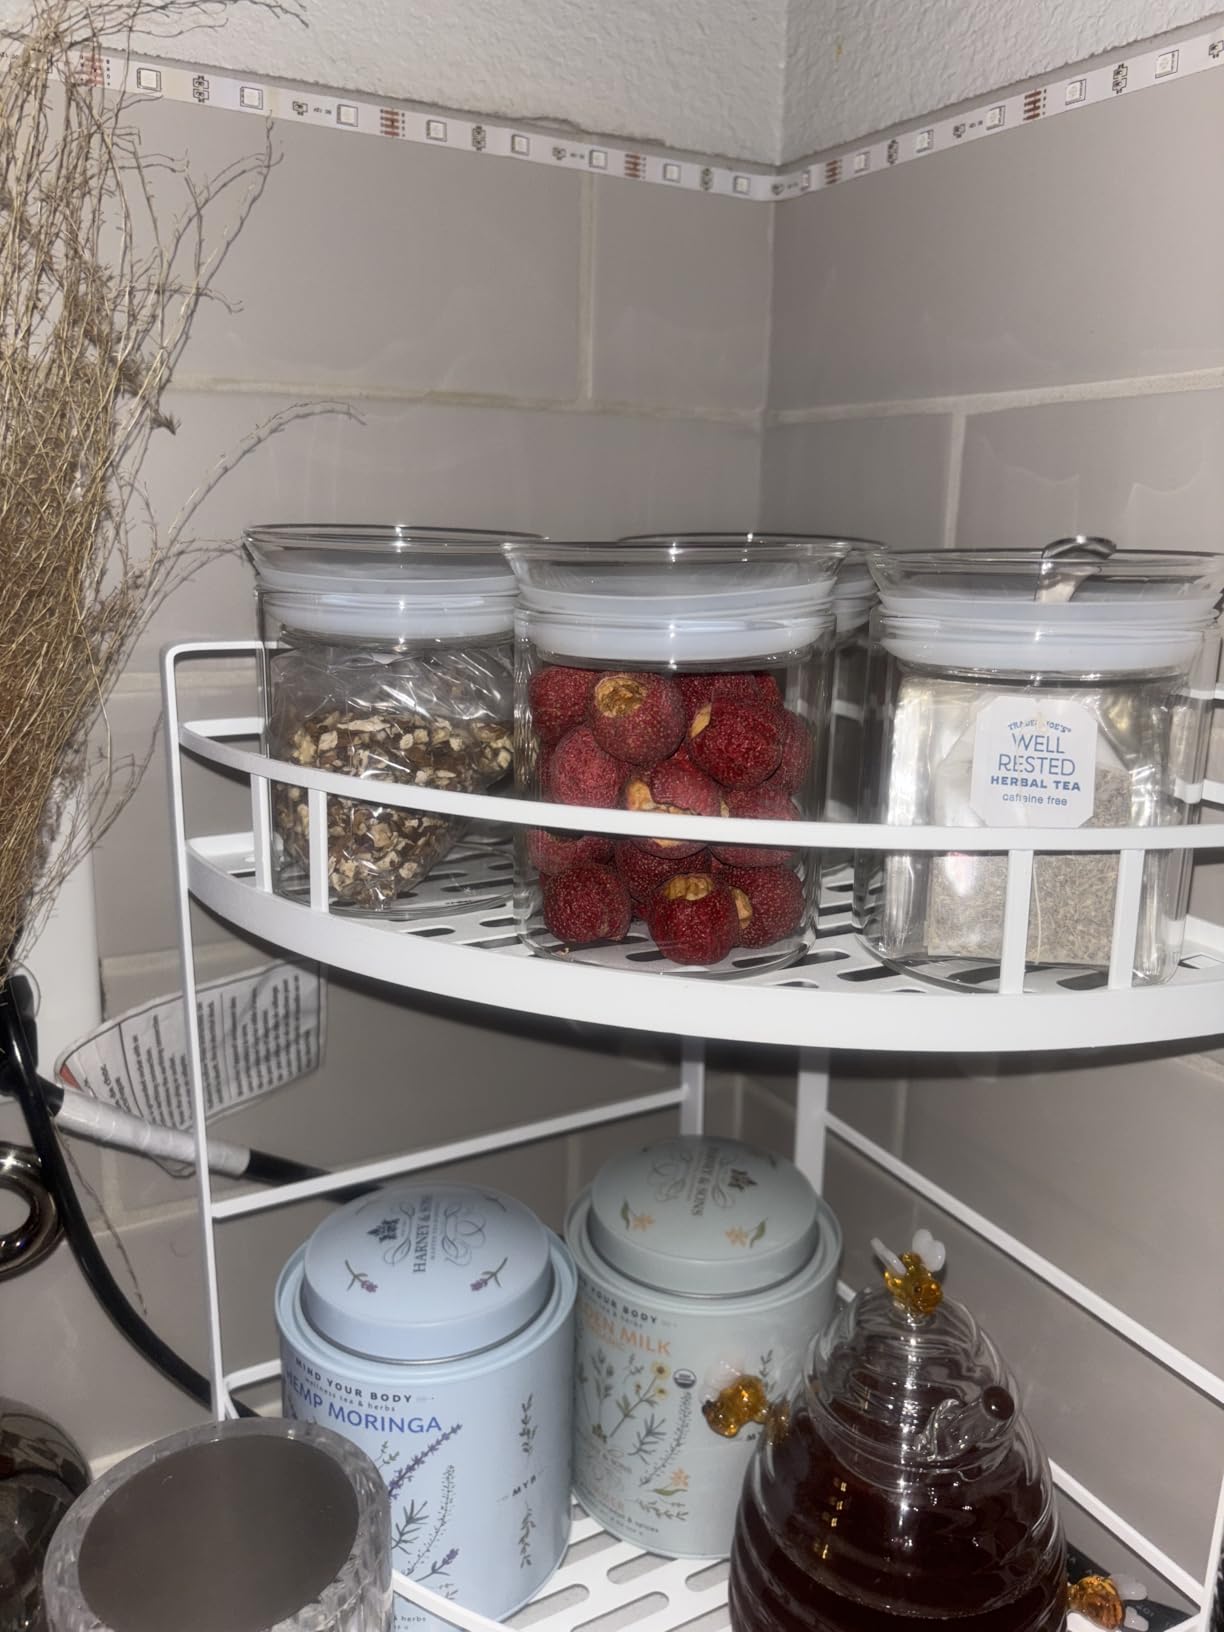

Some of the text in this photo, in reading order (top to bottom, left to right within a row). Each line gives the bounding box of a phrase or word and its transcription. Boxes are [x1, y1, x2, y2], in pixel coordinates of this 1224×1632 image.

[1046, 720, 1068, 733] OE'S
[1011, 733, 1065, 754] WELL
[998, 753, 1076, 776] RESTED
[990, 775, 1081, 792] HERBAL TEA
[1047, 795, 1068, 807] free
[413, 1223, 430, 1273] HARNEY
[622, 1306, 658, 1324] BODY
[619, 1327, 672, 1356] MILK
[295, 1357, 413, 1404] MIND YOUR BODY
[285, 1369, 442, 1434] HEMP MORINGA
